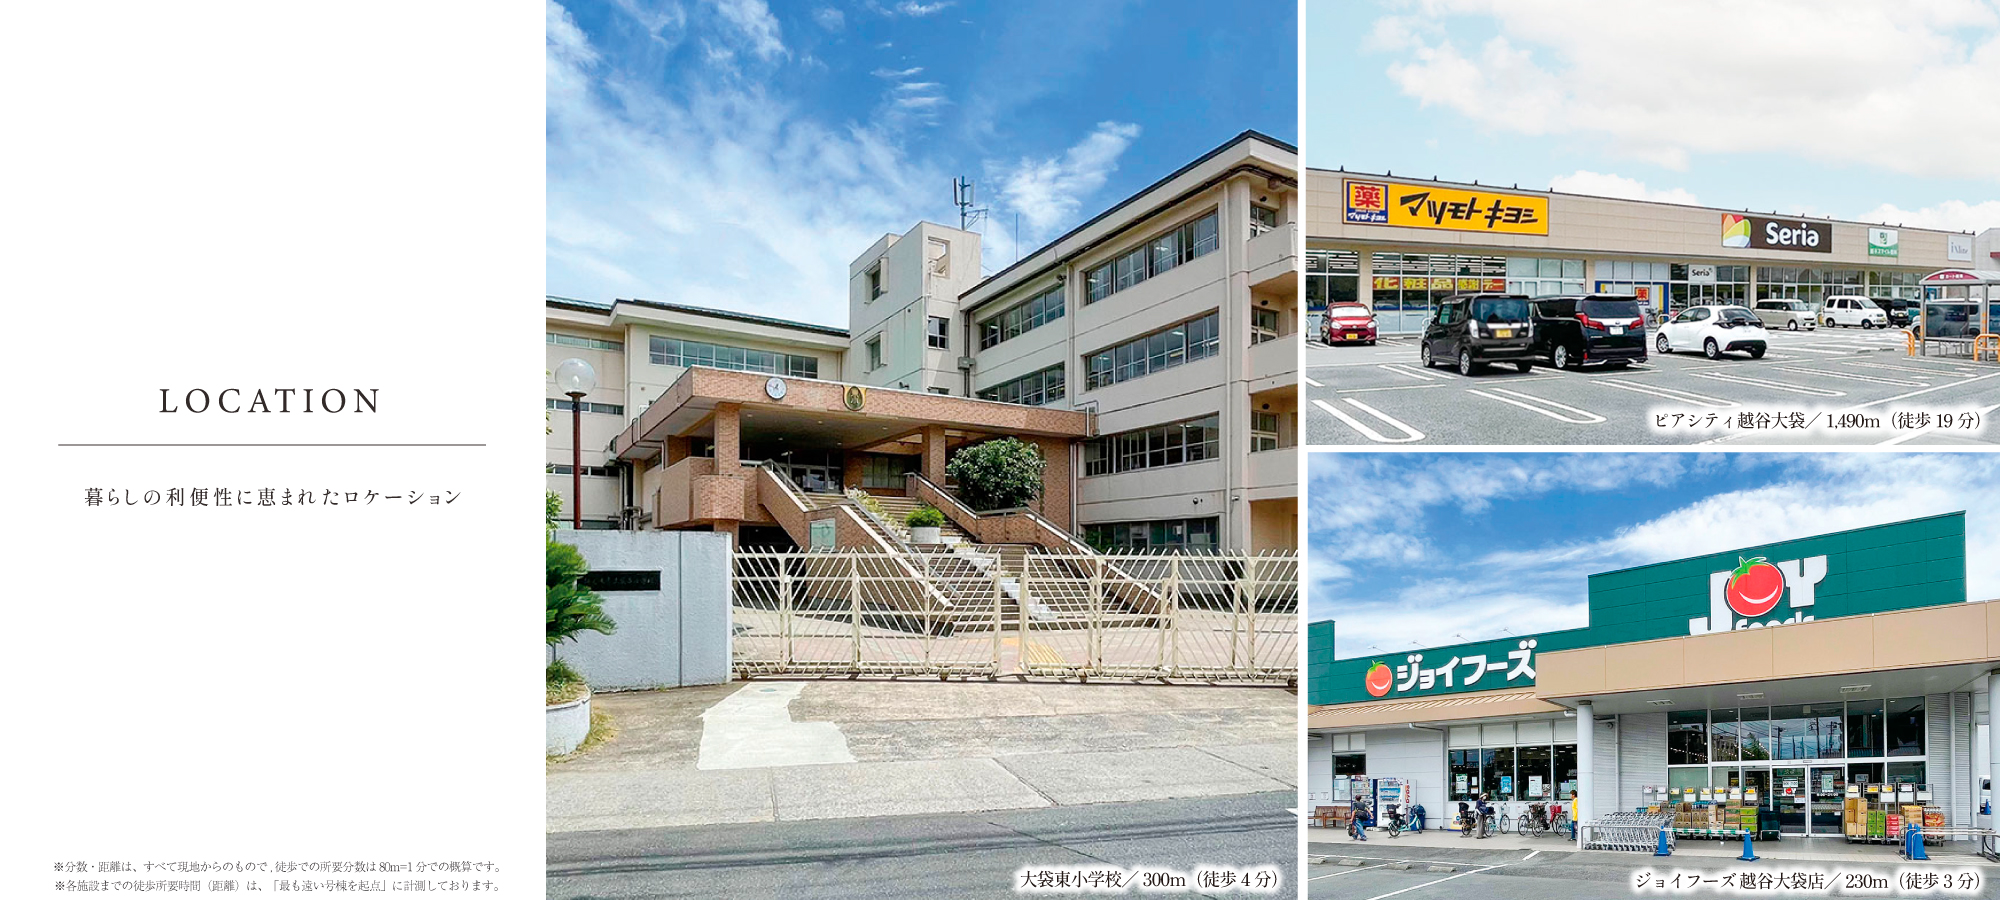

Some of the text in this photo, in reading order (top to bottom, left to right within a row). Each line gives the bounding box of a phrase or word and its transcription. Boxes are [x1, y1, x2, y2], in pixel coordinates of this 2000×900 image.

[1355, 186, 1380, 208] 薬
[1400, 192, 1538, 228] マツモトキヨシ
[1766, 222, 1819, 247] Seria
[1692, 268, 1710, 277] Seria
[1397, 639, 1537, 692] ジョイフーズ
